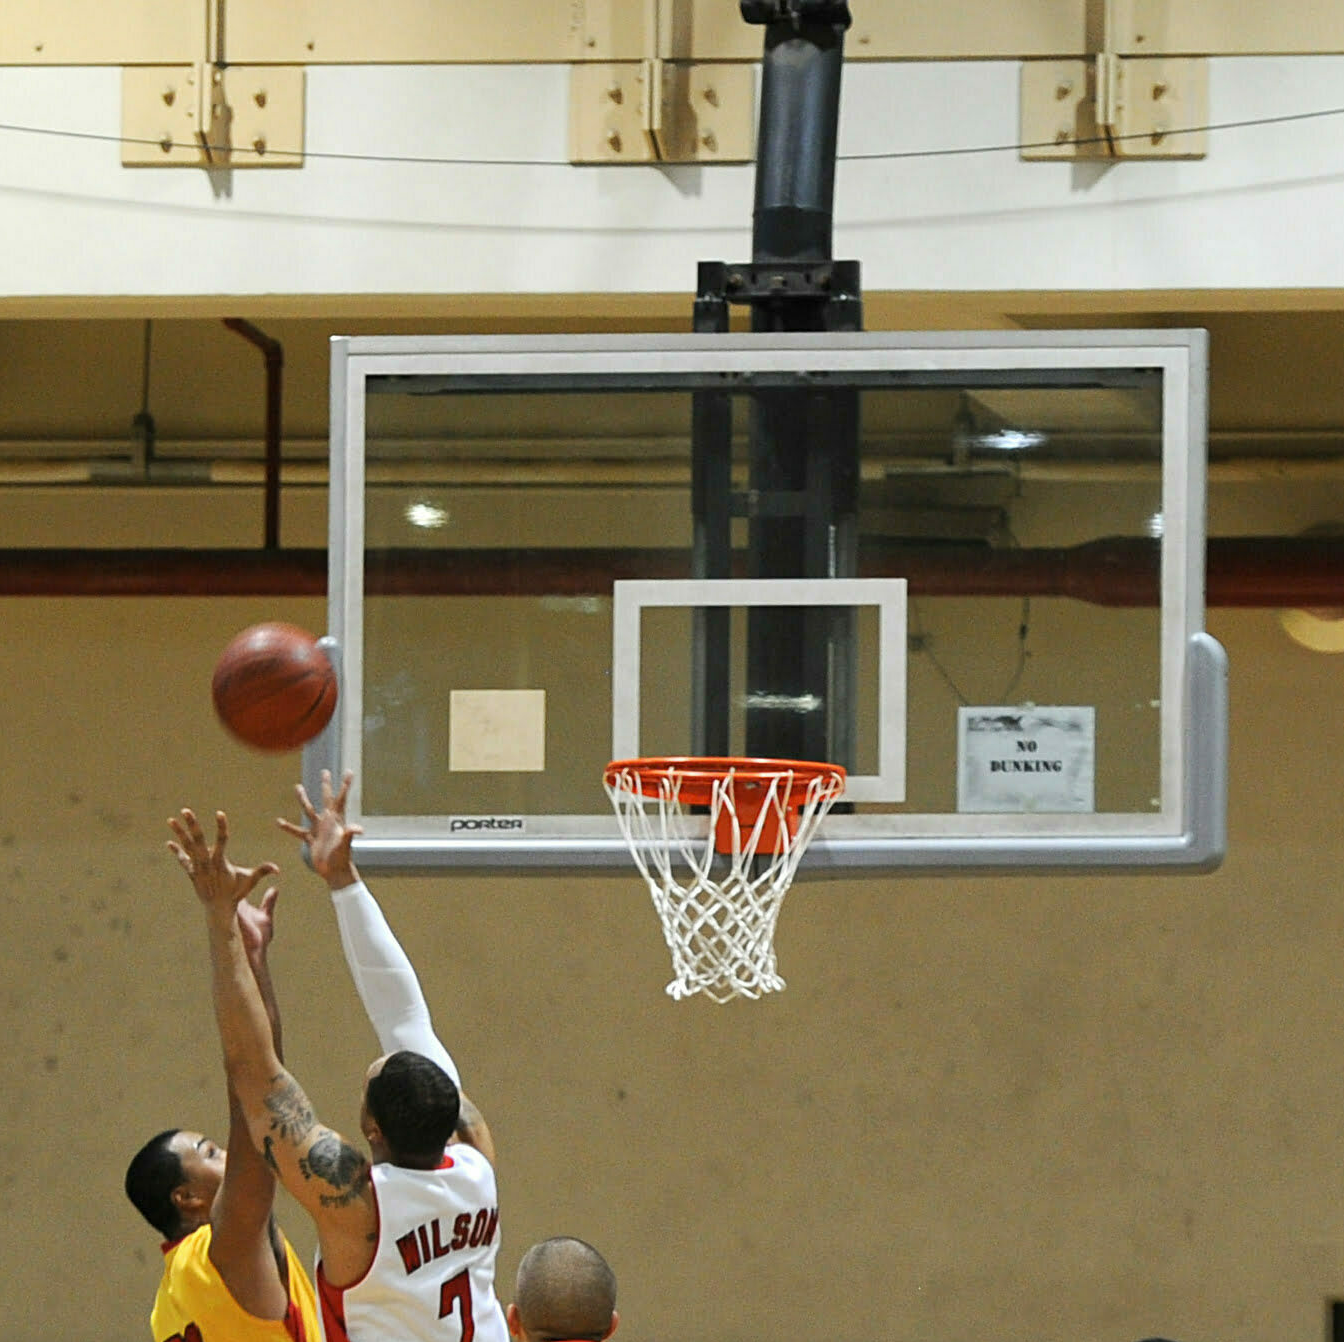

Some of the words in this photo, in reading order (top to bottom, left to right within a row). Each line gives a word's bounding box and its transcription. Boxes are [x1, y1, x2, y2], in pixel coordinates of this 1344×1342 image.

[1016, 740, 1038, 752] NO
[990, 760, 1063, 773] DUNKING
[395, 1207, 499, 1276] WILSON
